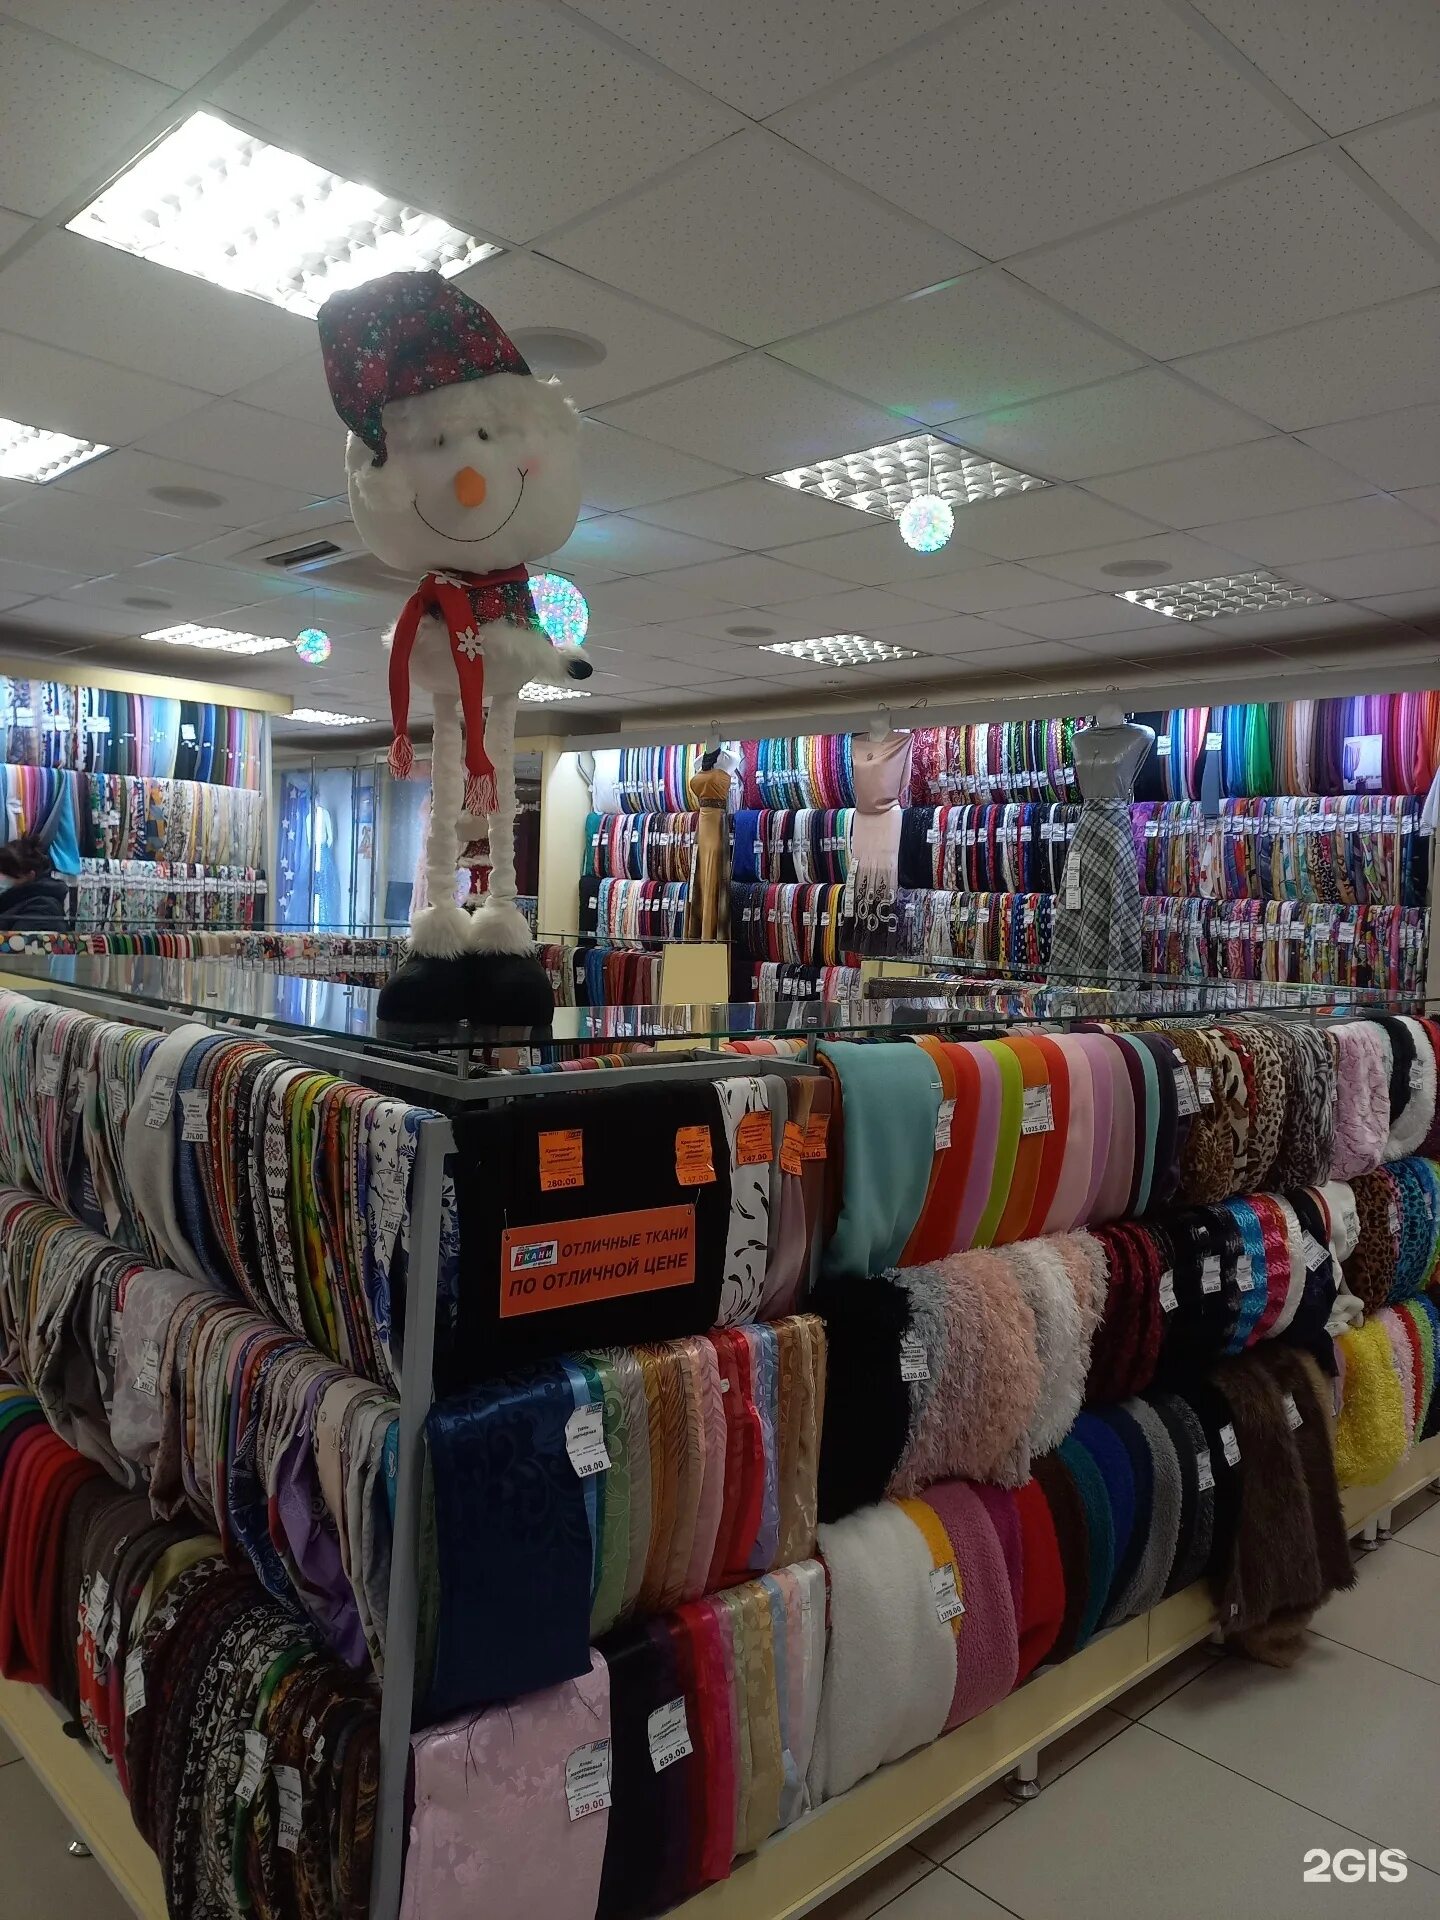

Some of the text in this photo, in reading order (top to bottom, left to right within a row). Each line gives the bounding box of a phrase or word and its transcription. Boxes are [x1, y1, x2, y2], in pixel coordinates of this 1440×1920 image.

[547, 1177, 577, 1188] 280.00
[561, 1226, 688, 1258] ОТЛИЧНЫЕ ТКАНИ
[517, 1248, 552, 1263] ТКАНИ
[509, 1252, 689, 1297] ПО ОТЛИЧНОЙ ЦЕНЕ
[579, 1460, 604, 1475] 358.00
[660, 1746, 686, 1767] 659.00
[575, 1798, 604, 1816] 529.00
